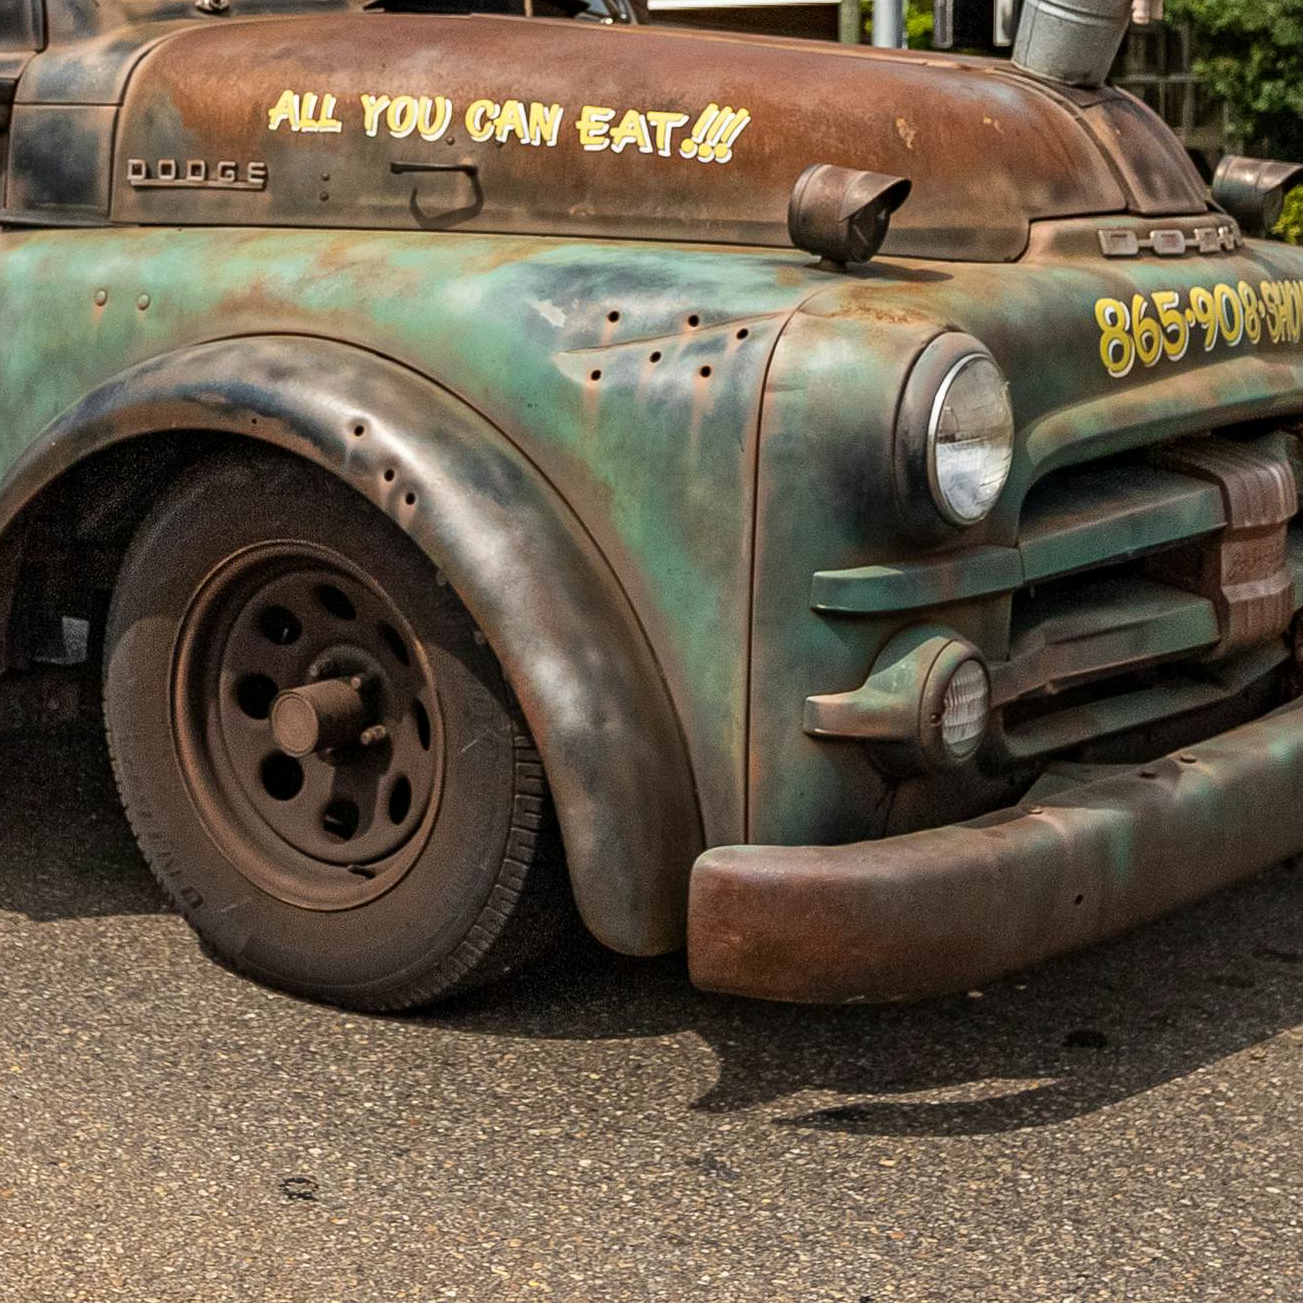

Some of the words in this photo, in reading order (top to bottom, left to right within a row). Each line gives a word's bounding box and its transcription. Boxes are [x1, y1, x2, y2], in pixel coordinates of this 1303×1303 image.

[268, 89, 342, 132] ALL
[360, 94, 452, 141] YOU
[464, 99, 564, 146] CAN
[575, 101, 751, 164] EAT!!!
[127, 158, 268, 184] DODGE
